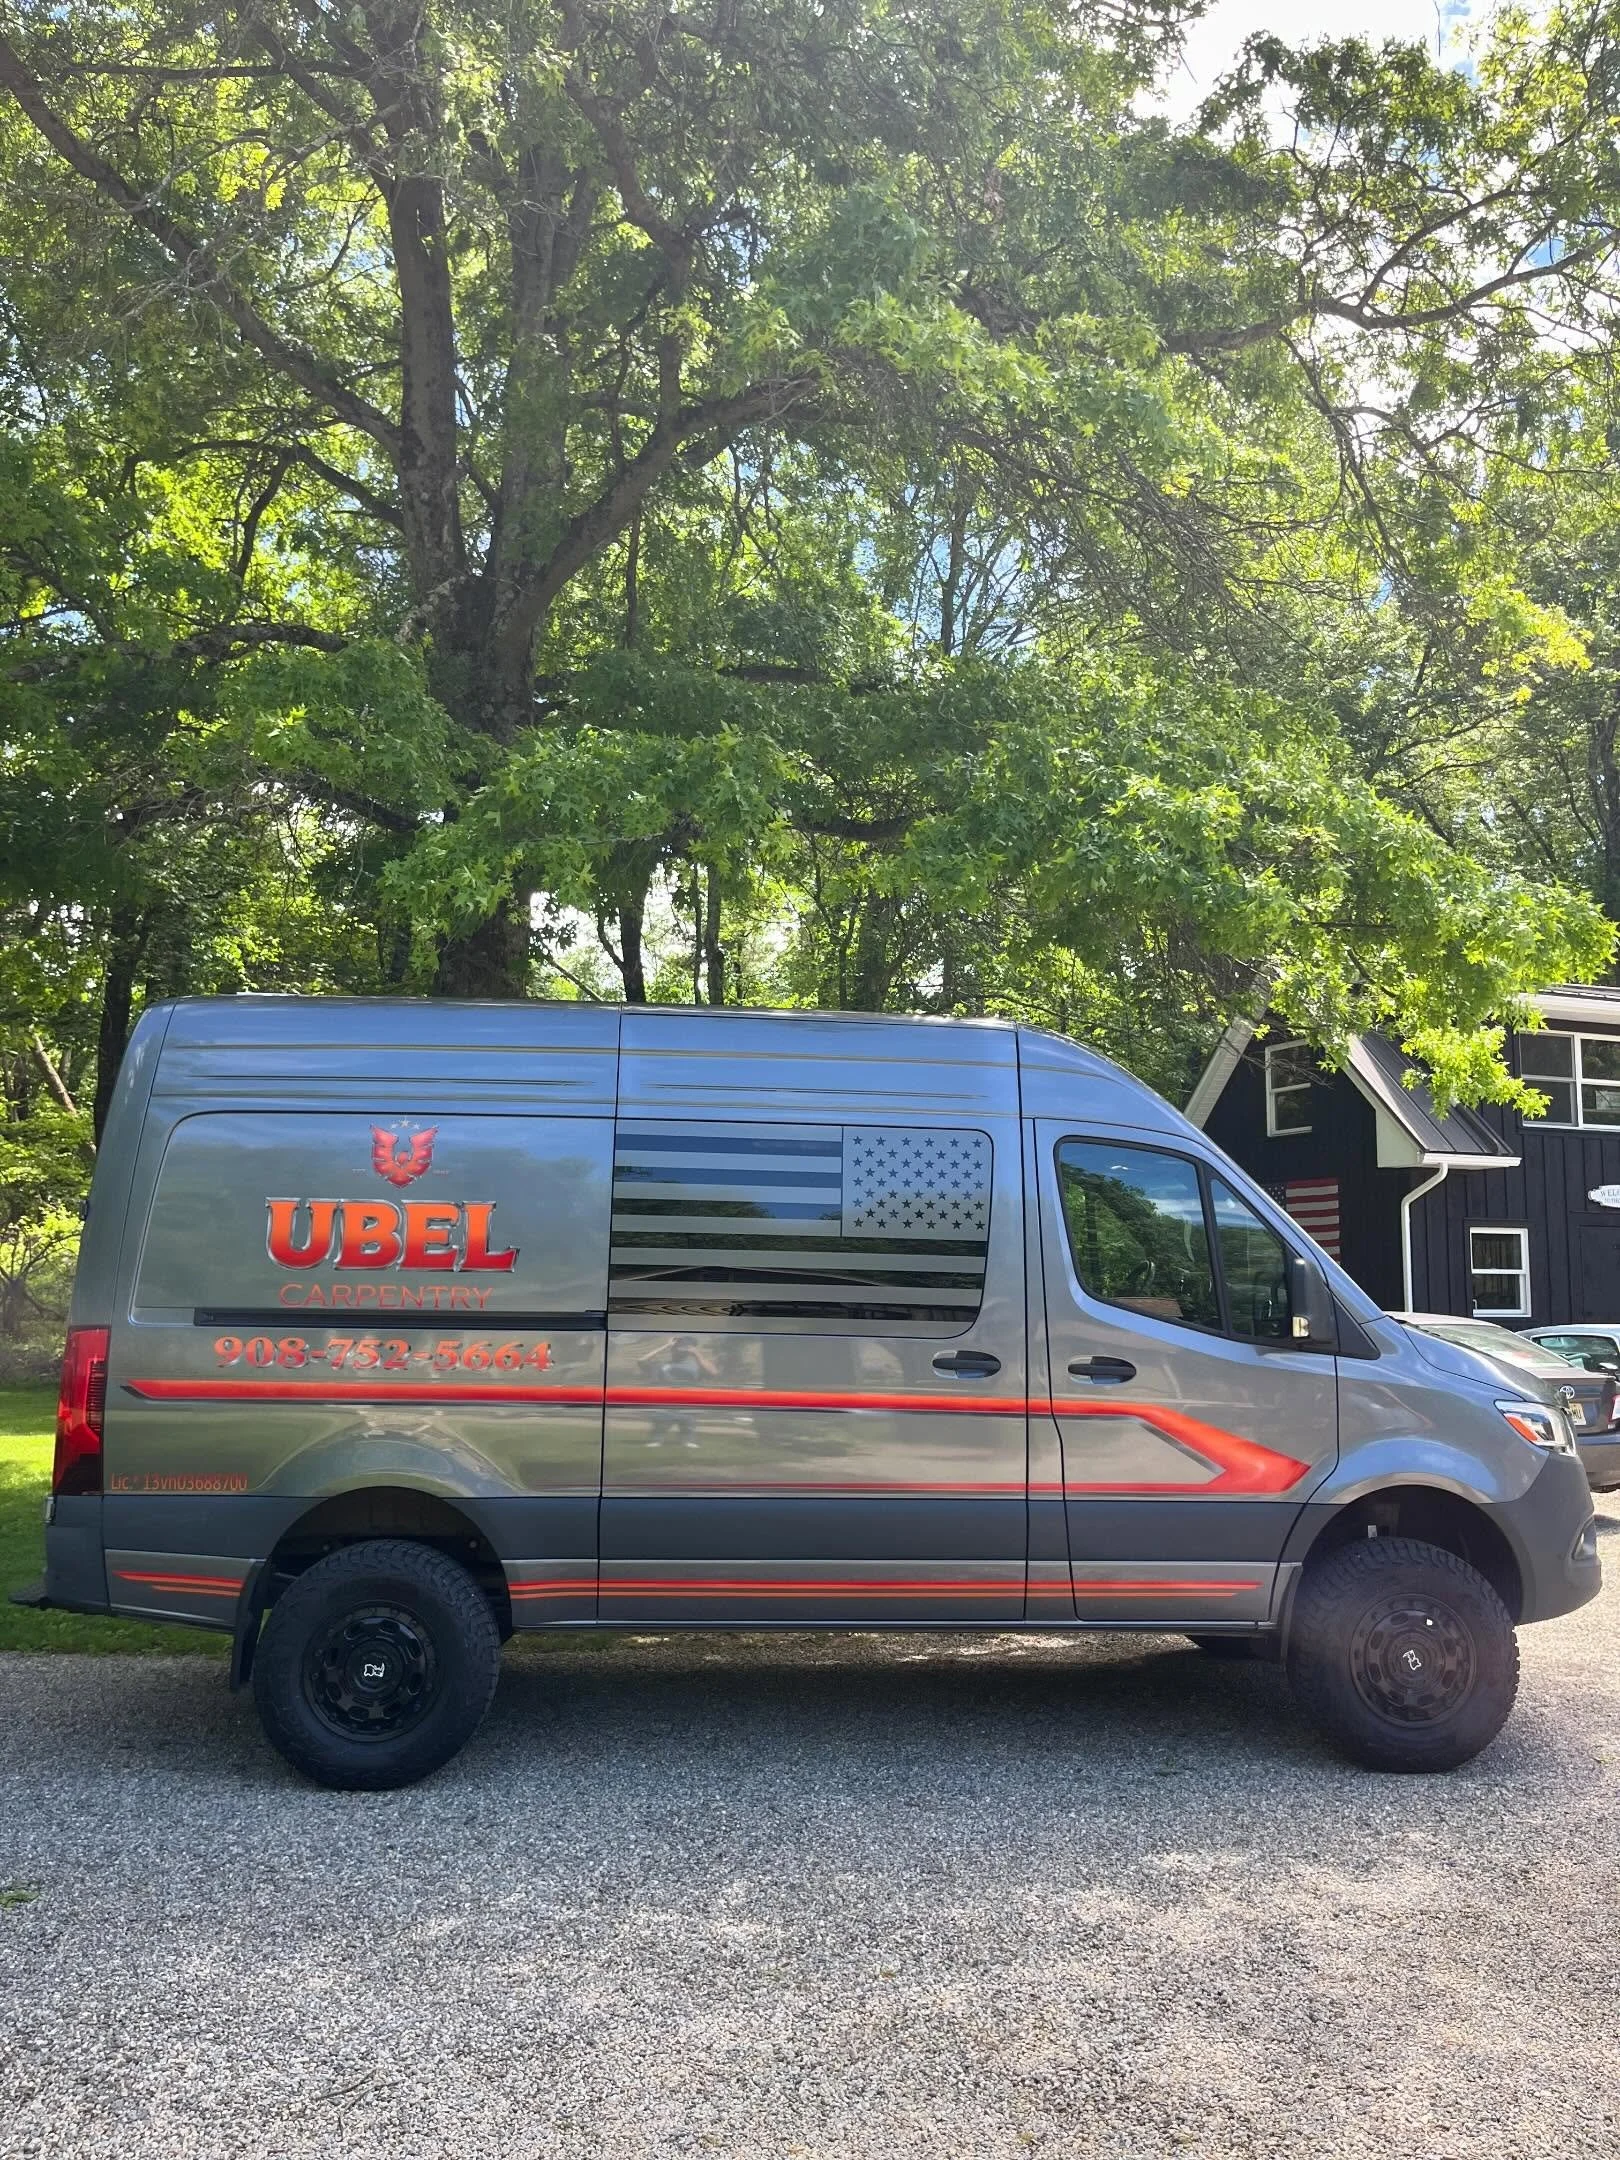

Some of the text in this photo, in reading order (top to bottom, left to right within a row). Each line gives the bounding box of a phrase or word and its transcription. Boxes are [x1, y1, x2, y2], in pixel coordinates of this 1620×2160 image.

[265, 1197, 520, 1272] UBEL
[279, 1283, 493, 1309] CARPENTRY
[213, 1336, 555, 1371] 908-752-5664
